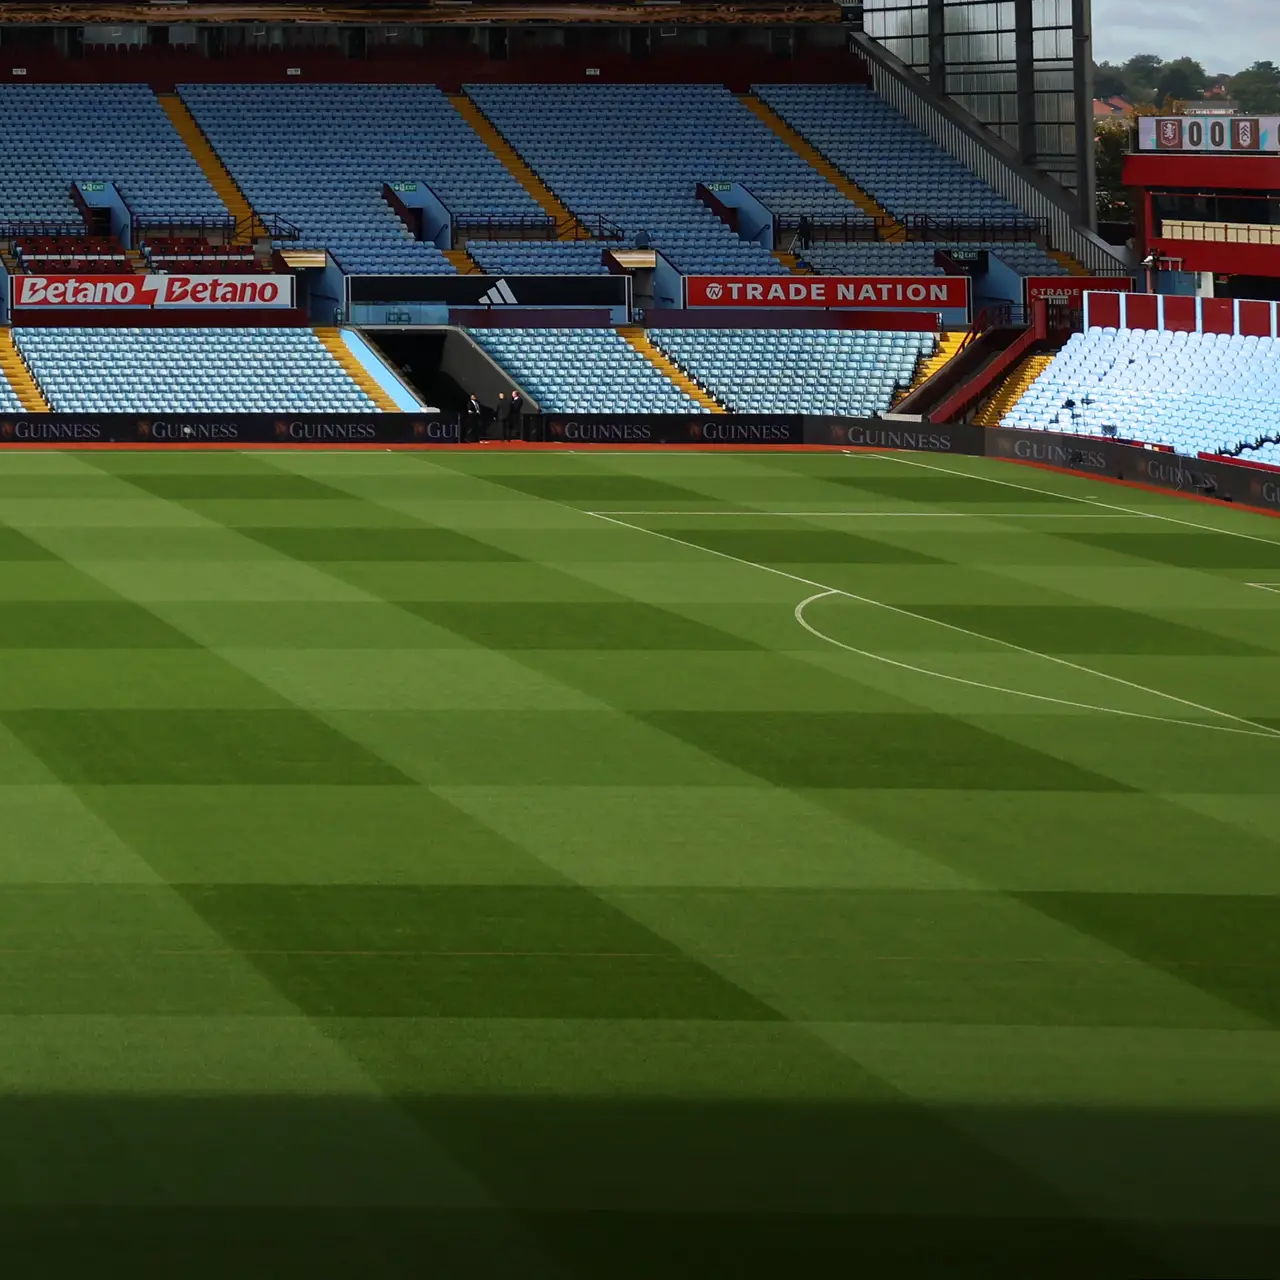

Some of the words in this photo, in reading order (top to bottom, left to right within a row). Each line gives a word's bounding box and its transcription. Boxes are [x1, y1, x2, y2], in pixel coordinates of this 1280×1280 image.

[1189, 121, 1202, 146] 0
[1211, 121, 1224, 146] 0
[20, 278, 135, 303] Betano
[165, 277, 278, 302] Betano
[727, 283, 825, 300] TRADE
[837, 284, 948, 301] NATION
[1040, 288, 1080, 296] TRADE
[14, 421, 101, 438] GUINNESS
[289, 421, 376, 438] GUINNESS
[564, 422, 652, 439] GUINNESS
[703, 423, 790, 440] GUINNESS
[848, 426, 951, 449] GUINNESS
